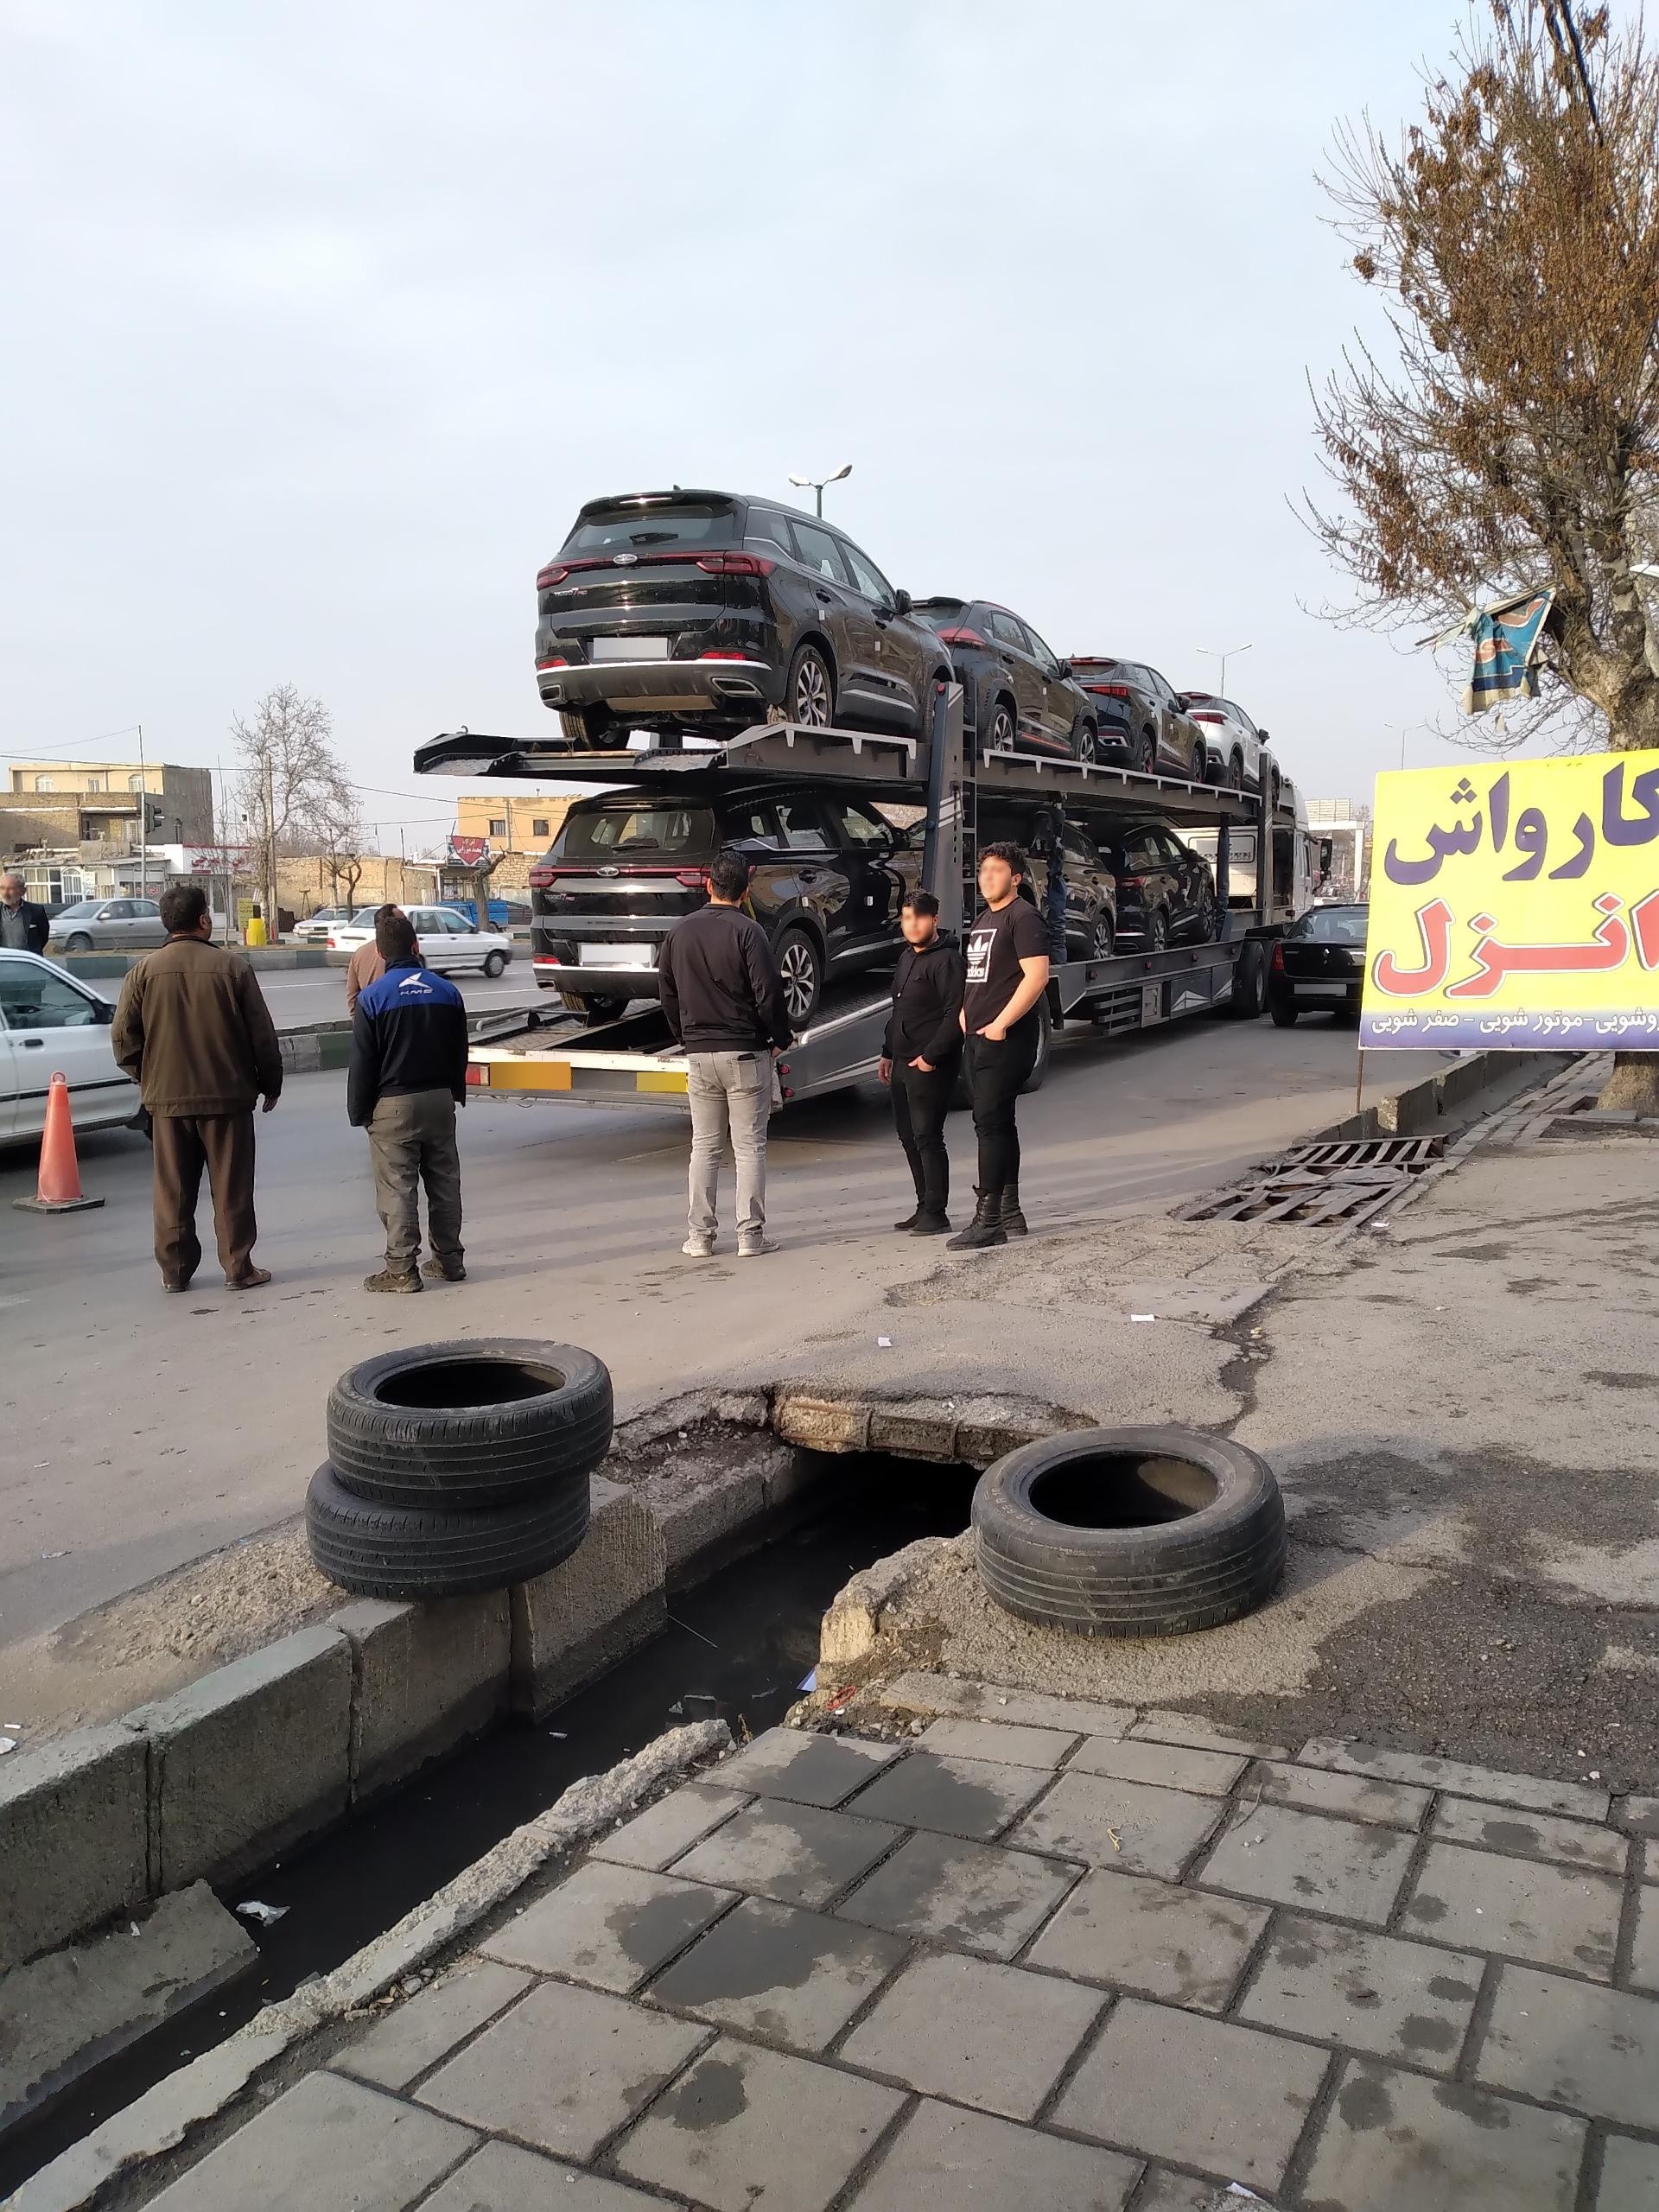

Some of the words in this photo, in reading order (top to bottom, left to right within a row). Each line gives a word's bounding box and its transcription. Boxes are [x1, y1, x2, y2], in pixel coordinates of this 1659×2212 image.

[1383, 760, 1659, 886] کارواش
[1371, 1008, 1418, 1035] شویی
[1421, 1009, 1460, 1033] صفر
[1479, 1007, 1529, 1035] شویی
